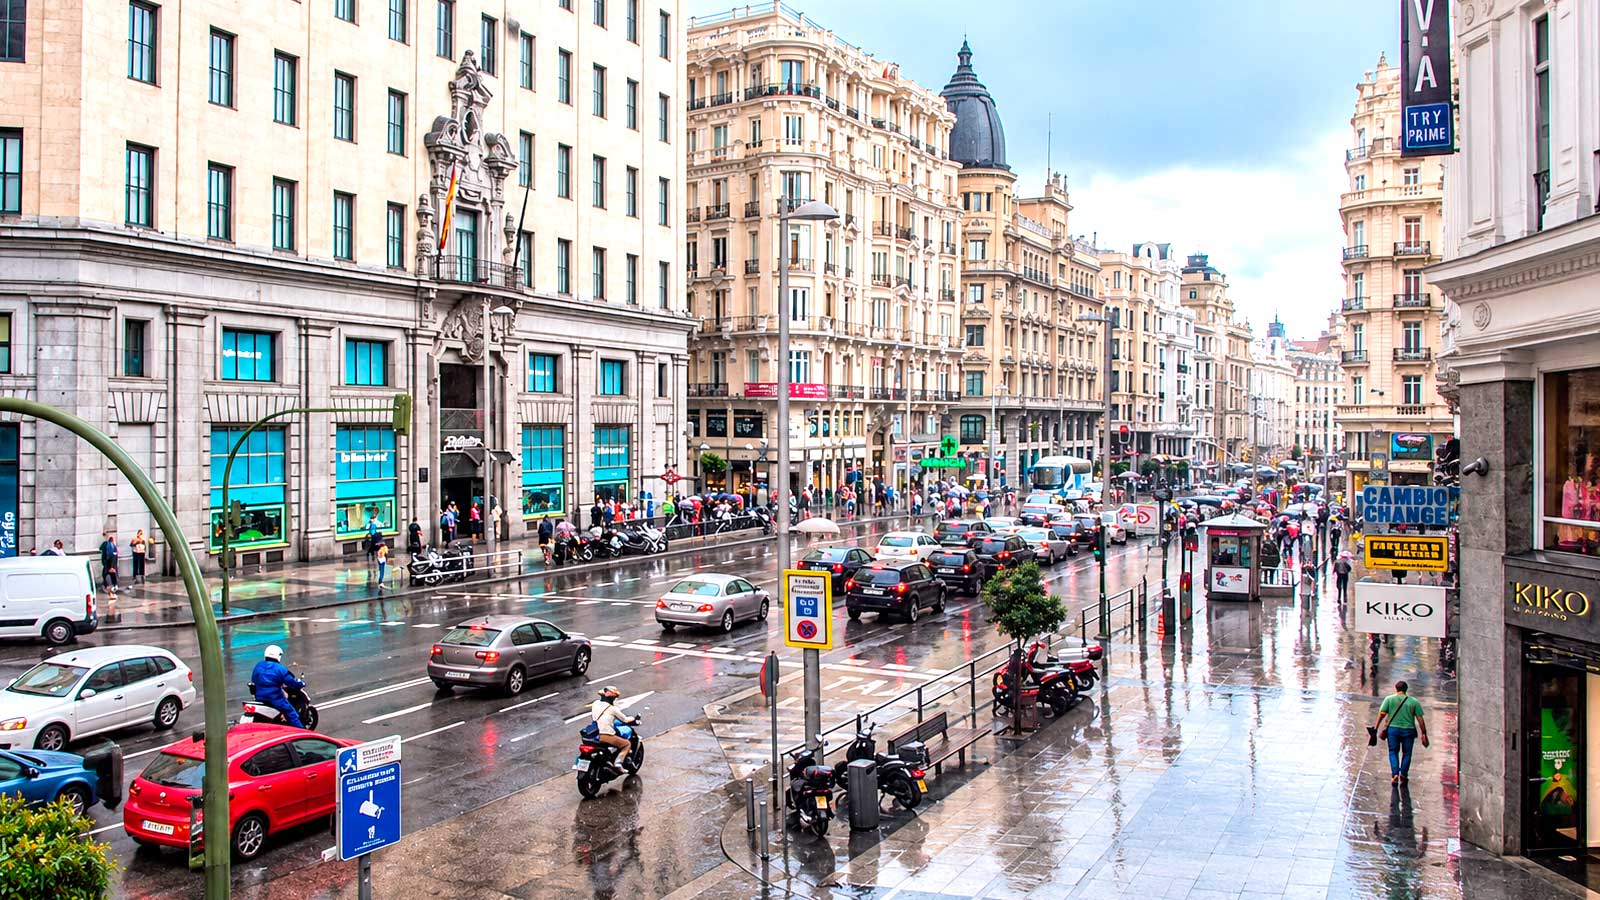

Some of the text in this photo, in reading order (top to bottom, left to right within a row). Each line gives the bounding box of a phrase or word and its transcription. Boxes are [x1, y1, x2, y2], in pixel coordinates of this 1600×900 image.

[1410, 110, 1441, 126] TRY
[1409, 128, 1446, 142] PRIME
[1363, 487, 1447, 506] CAMBIO
[1364, 506, 1446, 524] CHANGE
[1515, 582, 1589, 616] KIKO
[1366, 601, 1434, 618] KIKO
